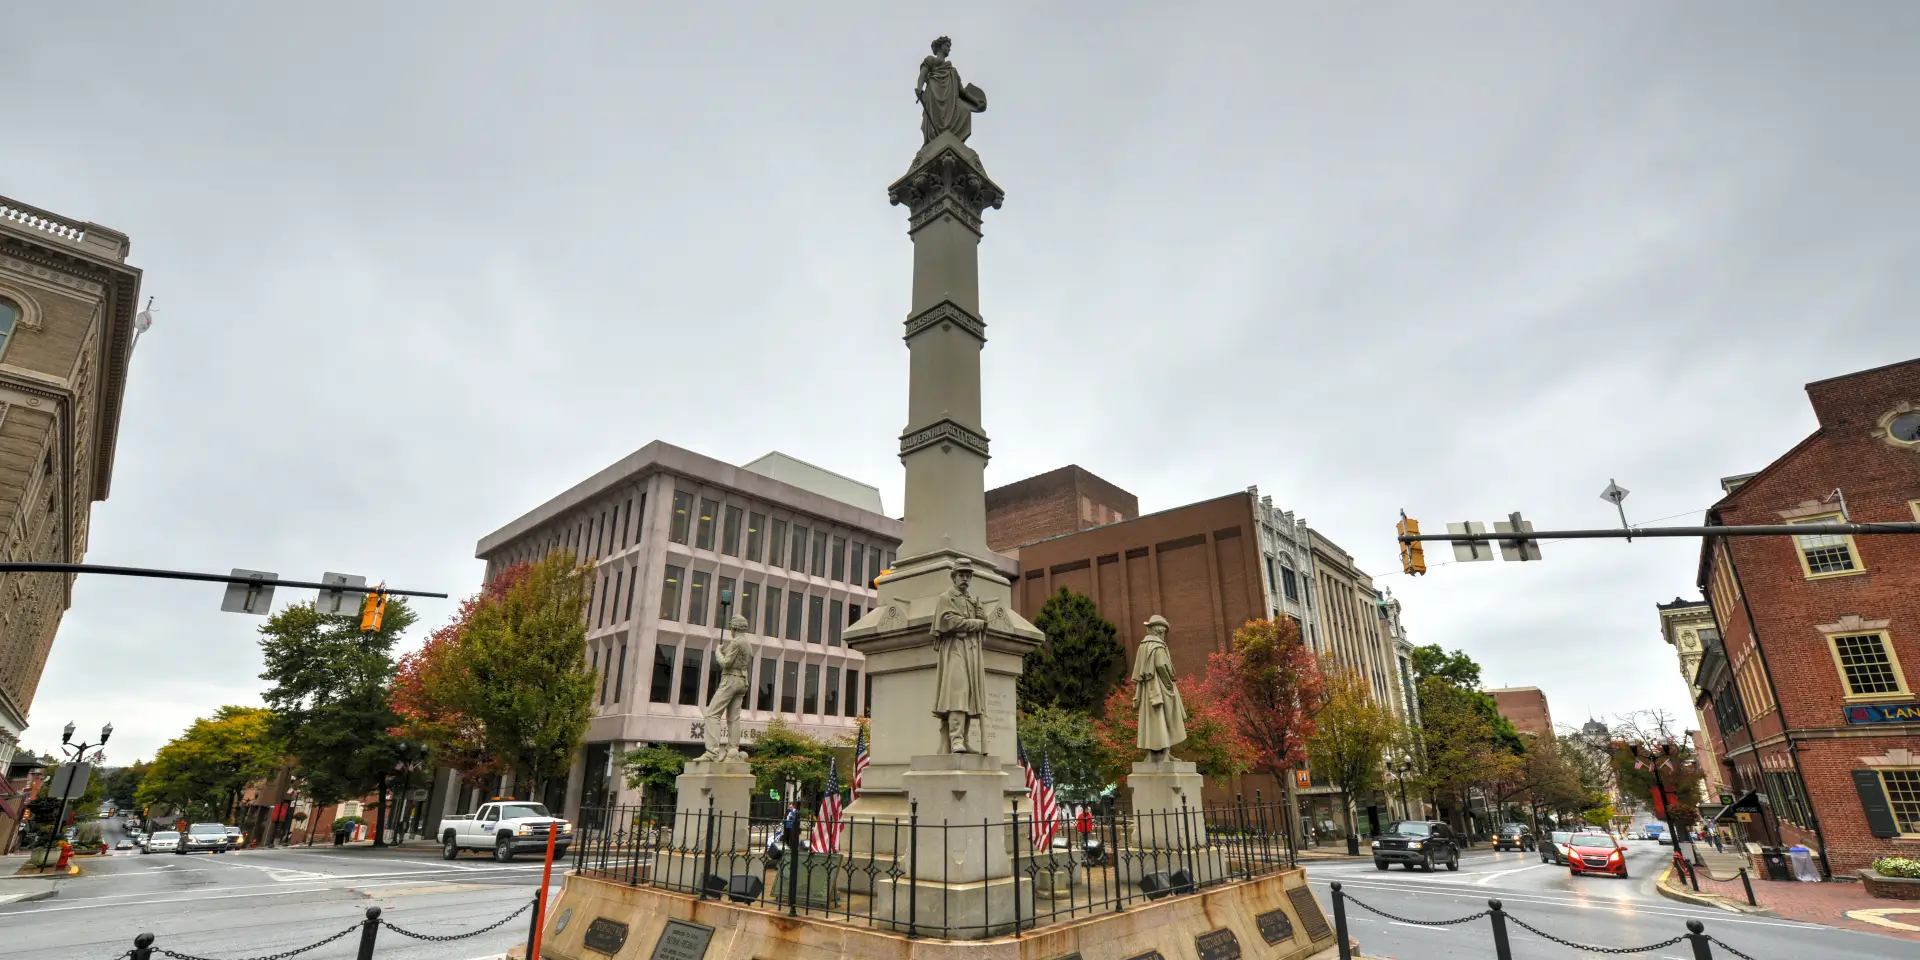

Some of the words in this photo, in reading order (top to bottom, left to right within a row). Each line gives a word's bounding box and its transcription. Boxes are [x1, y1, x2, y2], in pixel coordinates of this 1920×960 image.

[907, 306, 946, 334] VICKSBURG
[949, 307, 984, 335] ANTIETAM
[948, 424, 989, 452] GETTYSBURG
